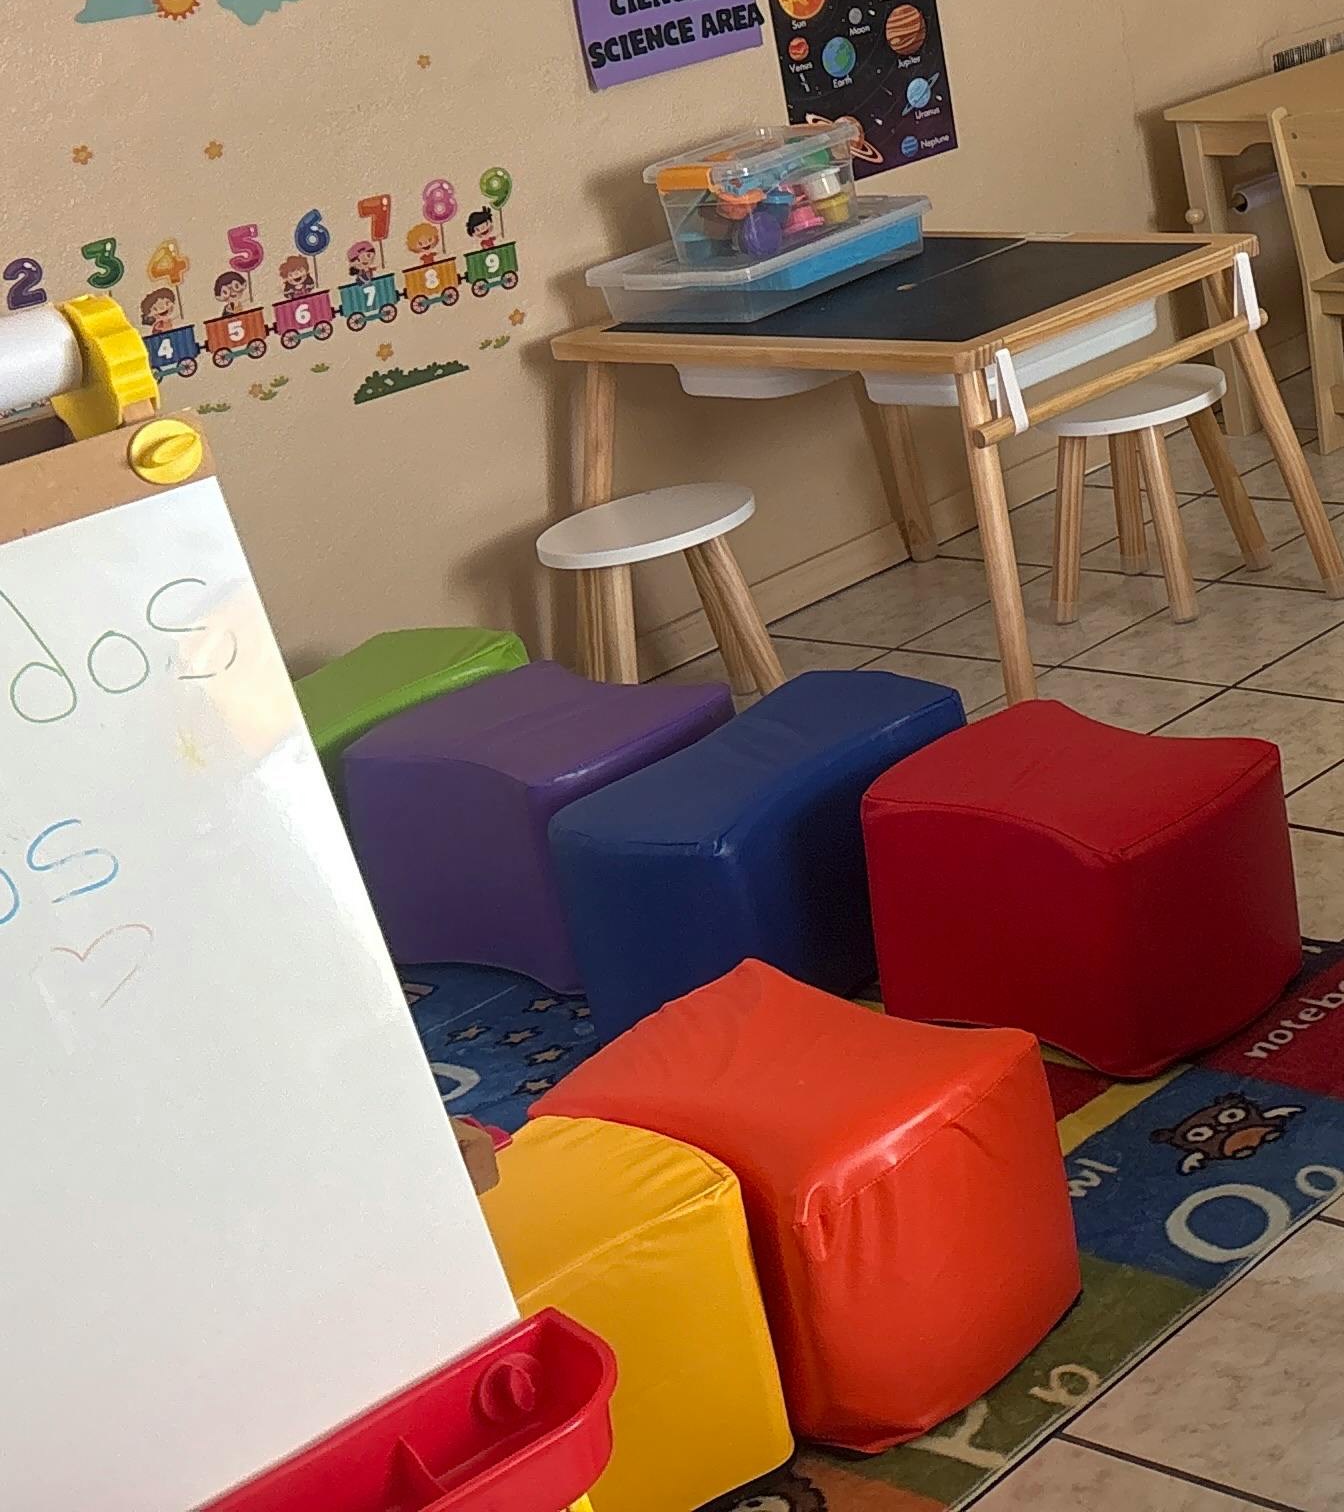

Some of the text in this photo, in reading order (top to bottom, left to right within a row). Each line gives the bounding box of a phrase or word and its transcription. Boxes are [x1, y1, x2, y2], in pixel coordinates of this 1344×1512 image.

[791, 19, 807, 30] Sun
[849, 23, 871, 36] Moon
[587, 2, 765, 69] SCIENCE AREA
[789, 61, 814, 74] Venus
[898, 55, 921, 69] Jupiter
[832, 75, 853, 89] Earth
[915, 106, 941, 120] Uranus
[920, 134, 950, 149] Neptune
[3, 167, 512, 309] 2 3 4 5 6 7 8 9
[157, 253, 500, 359] 4 5 6 7 8 9
[1066, 1156, 1119, 1198] wl
